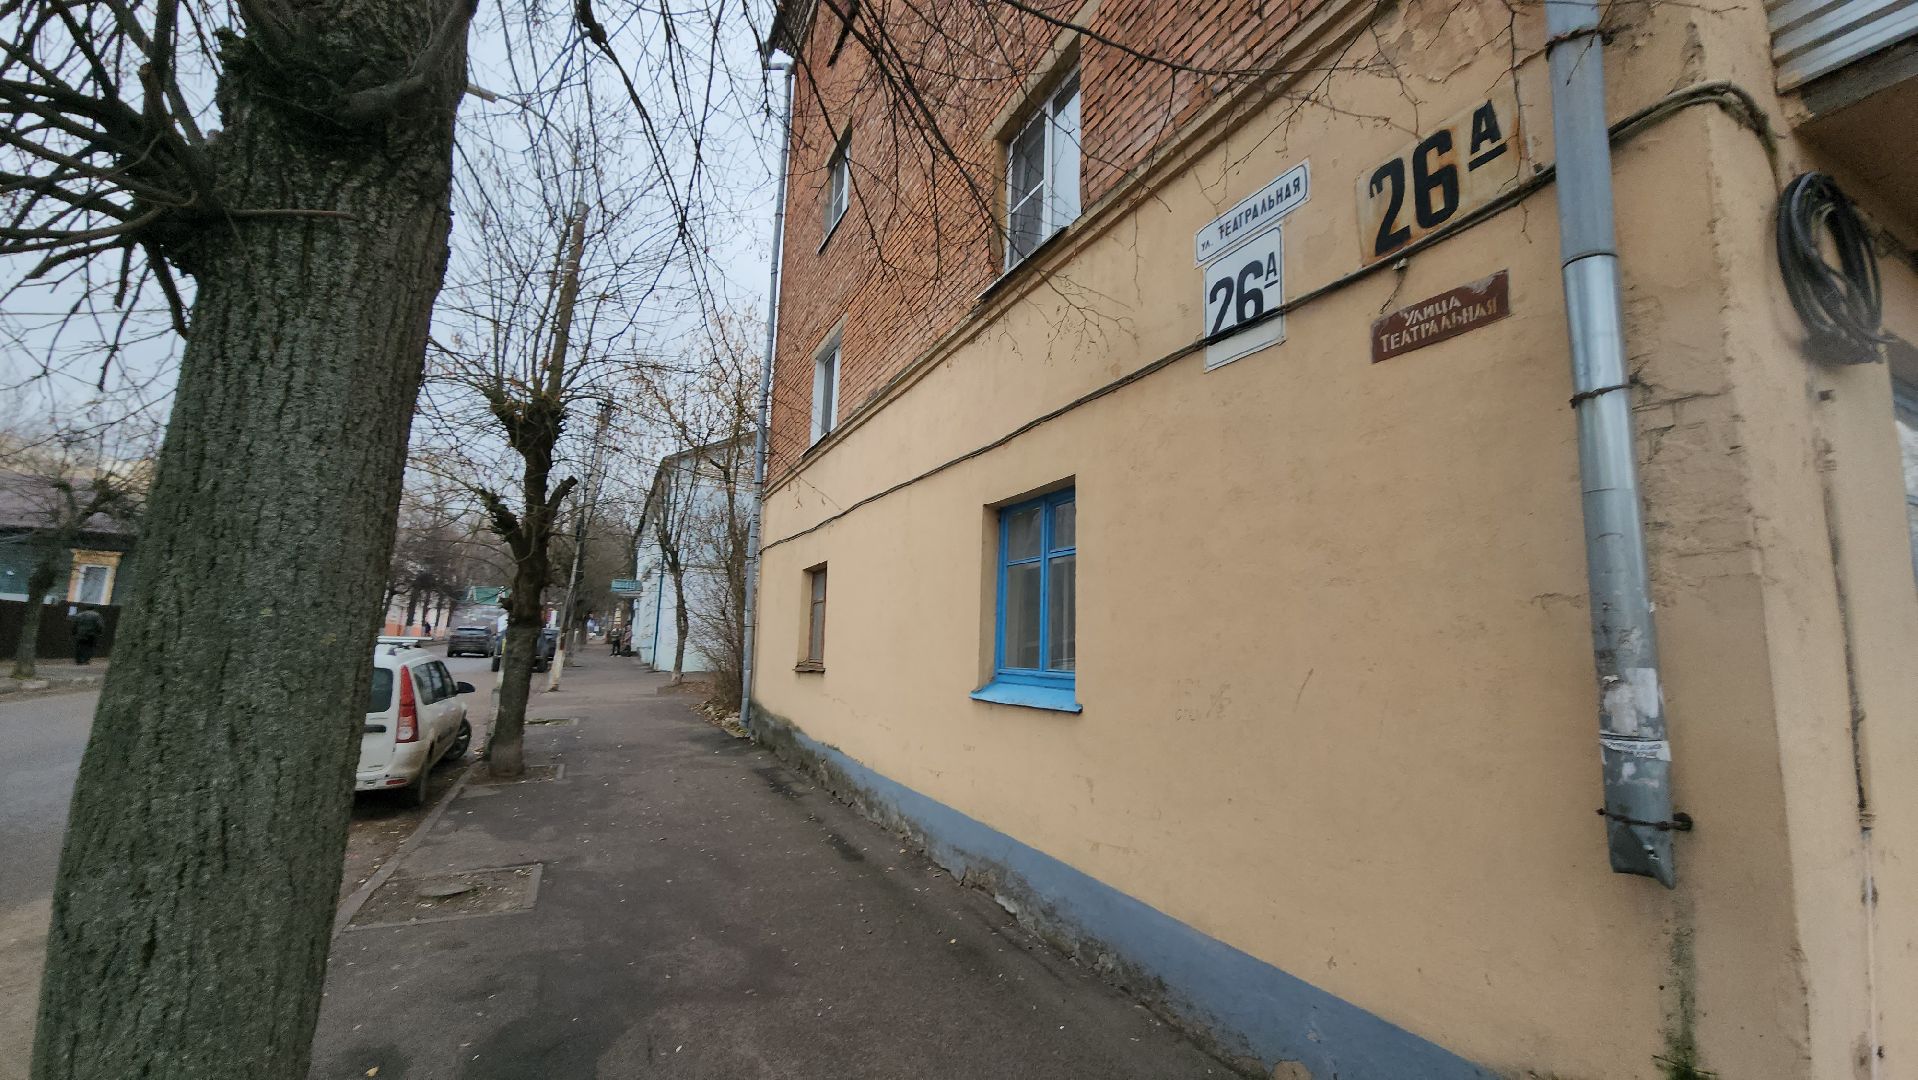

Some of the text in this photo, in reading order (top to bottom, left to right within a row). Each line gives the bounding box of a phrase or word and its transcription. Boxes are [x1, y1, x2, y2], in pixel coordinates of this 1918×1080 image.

[1218, 176, 1301, 240] ТЕАТРАЛЬНАЯ
[1380, 296, 1498, 353] ТЕАТРАЛЬНАЯ
[1402, 295, 1462, 327] УЛИЦА
